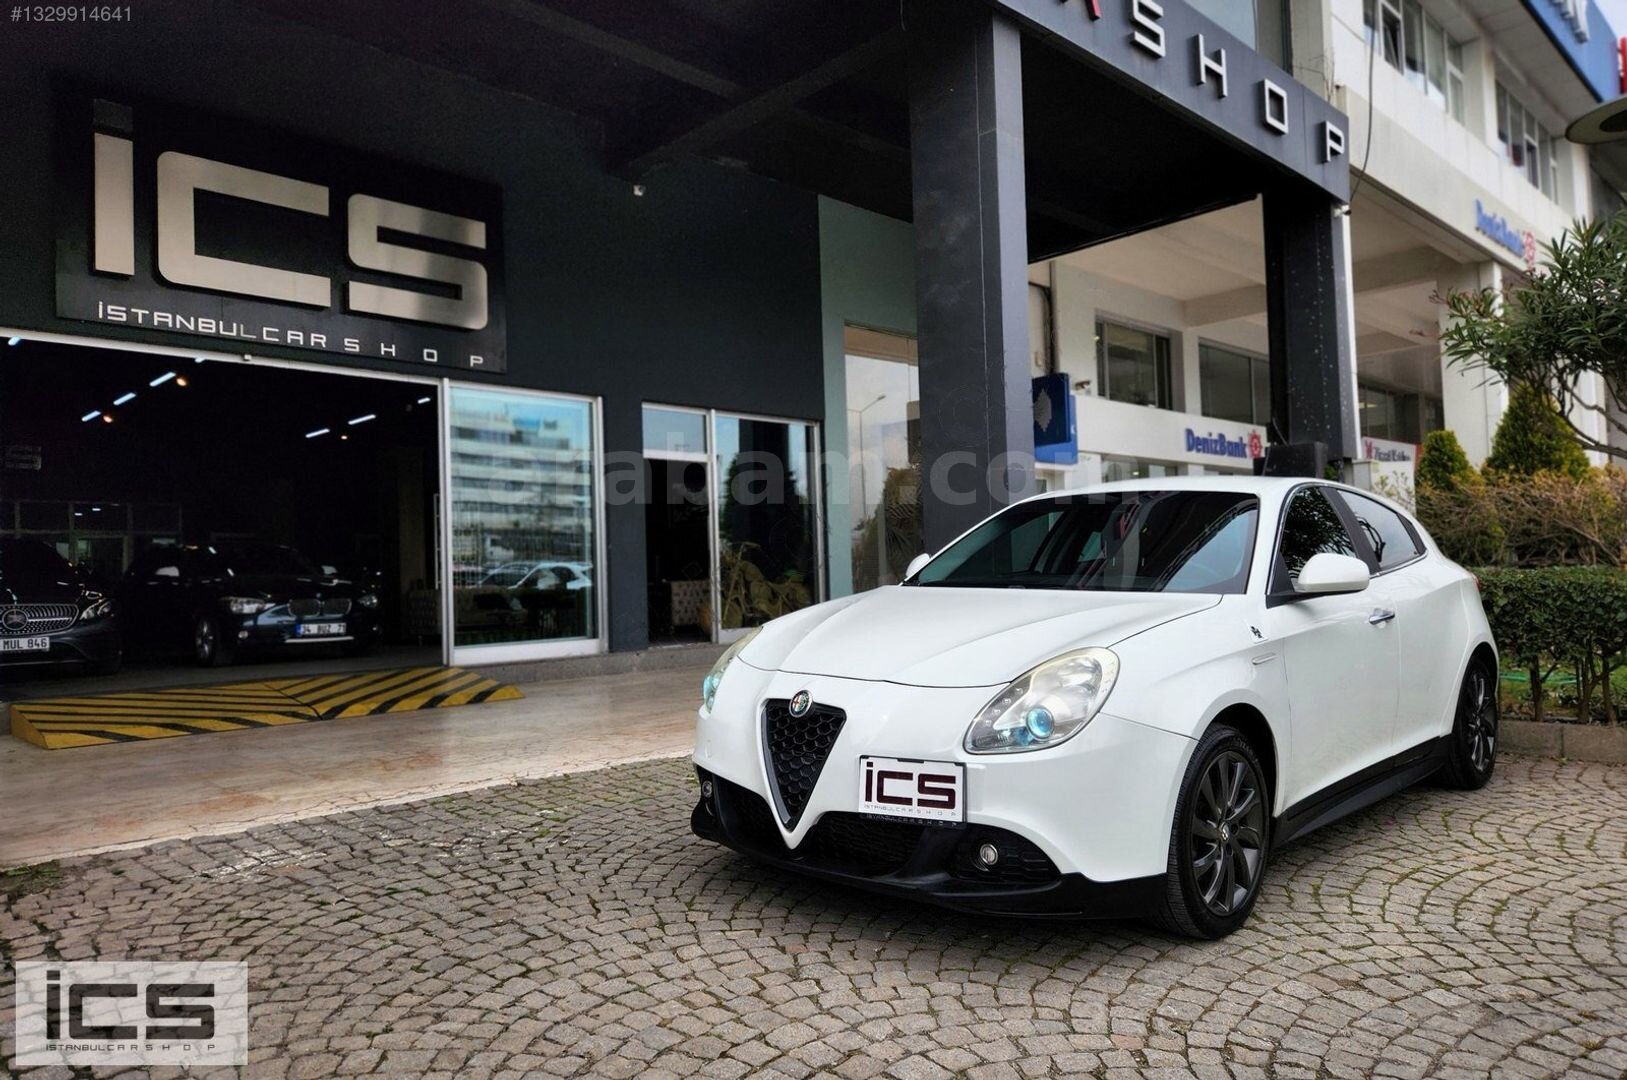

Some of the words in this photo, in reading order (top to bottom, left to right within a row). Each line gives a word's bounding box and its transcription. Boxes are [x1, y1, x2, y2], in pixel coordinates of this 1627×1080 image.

[1185, 427, 1248, 458] DenizBank
[3, 639, 23, 650] MUL
[27, 638, 47, 649] 846
